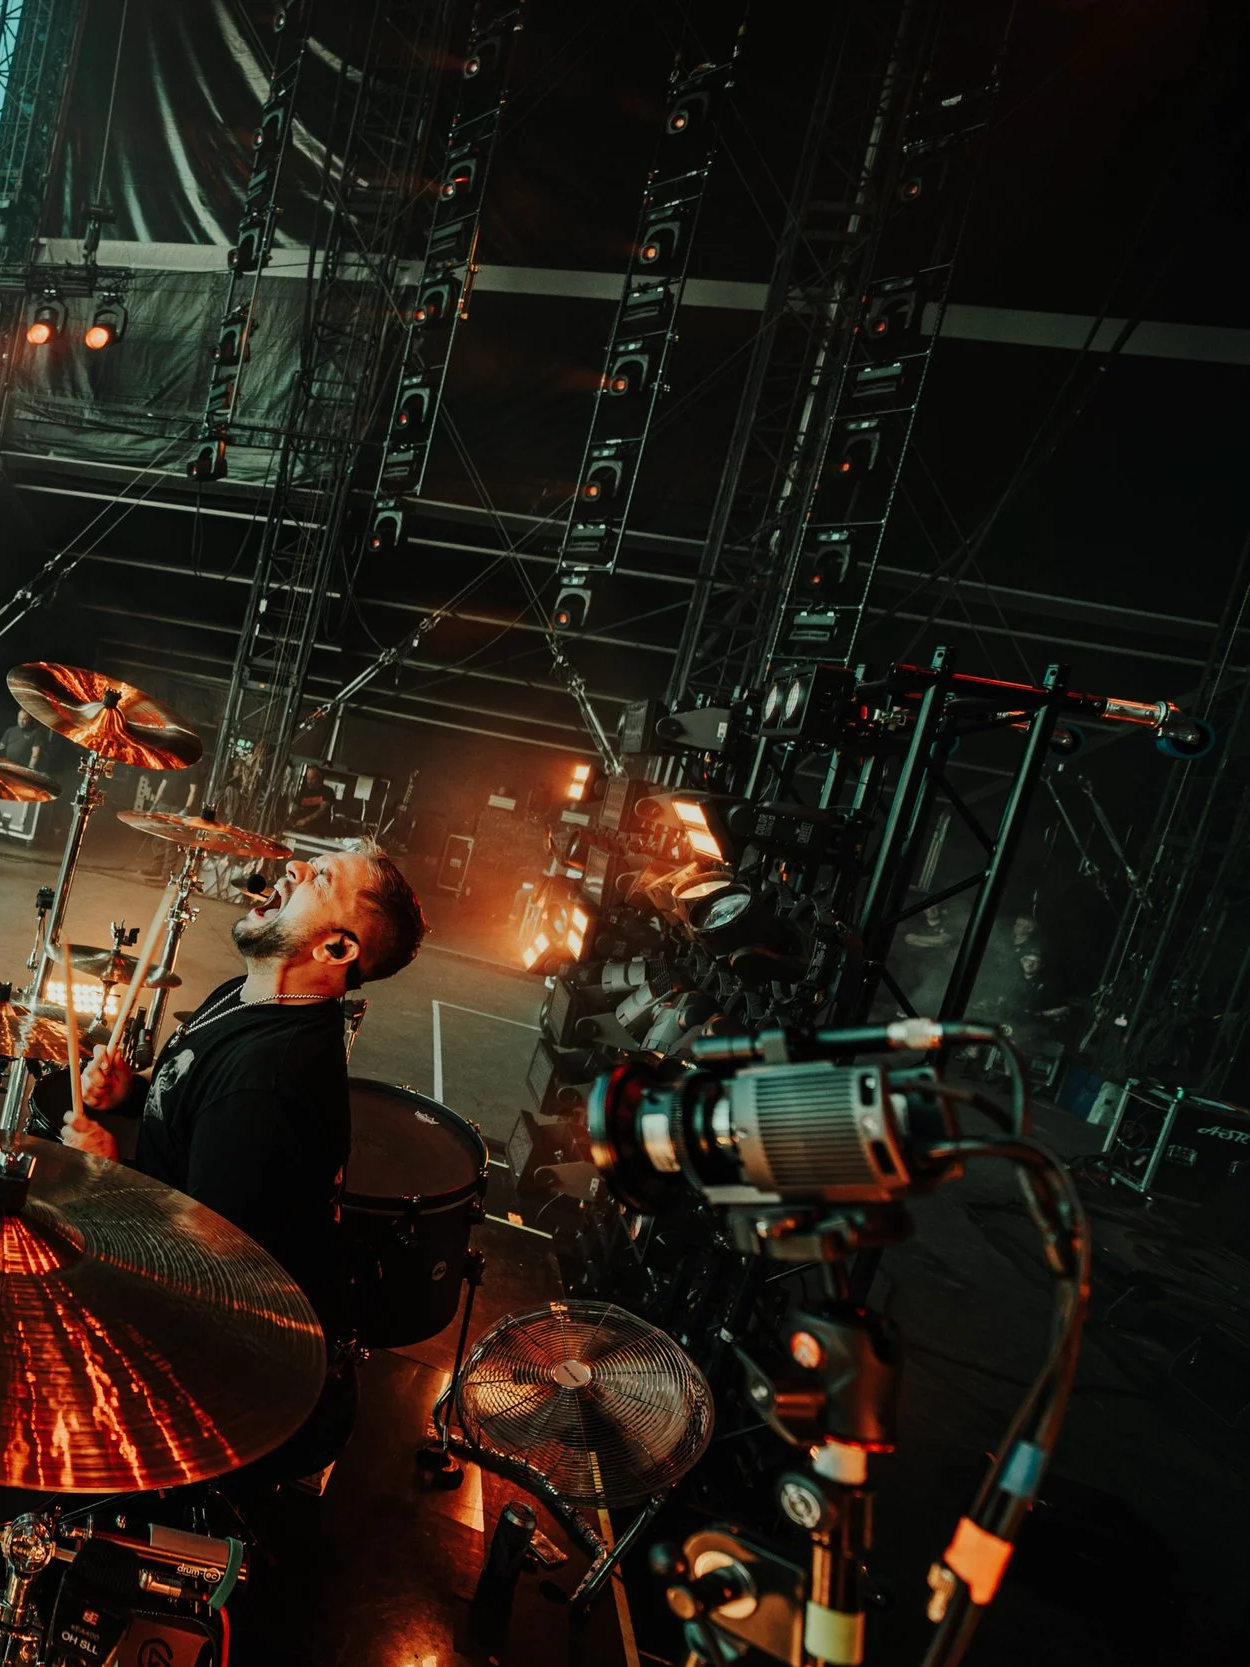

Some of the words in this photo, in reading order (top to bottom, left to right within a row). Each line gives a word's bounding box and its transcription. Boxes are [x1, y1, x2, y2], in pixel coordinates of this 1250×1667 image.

[177, 1563, 221, 1583] drum-tec
[61, 1630, 78, 1645] OH
[79, 1639, 98, 1655] SLL
